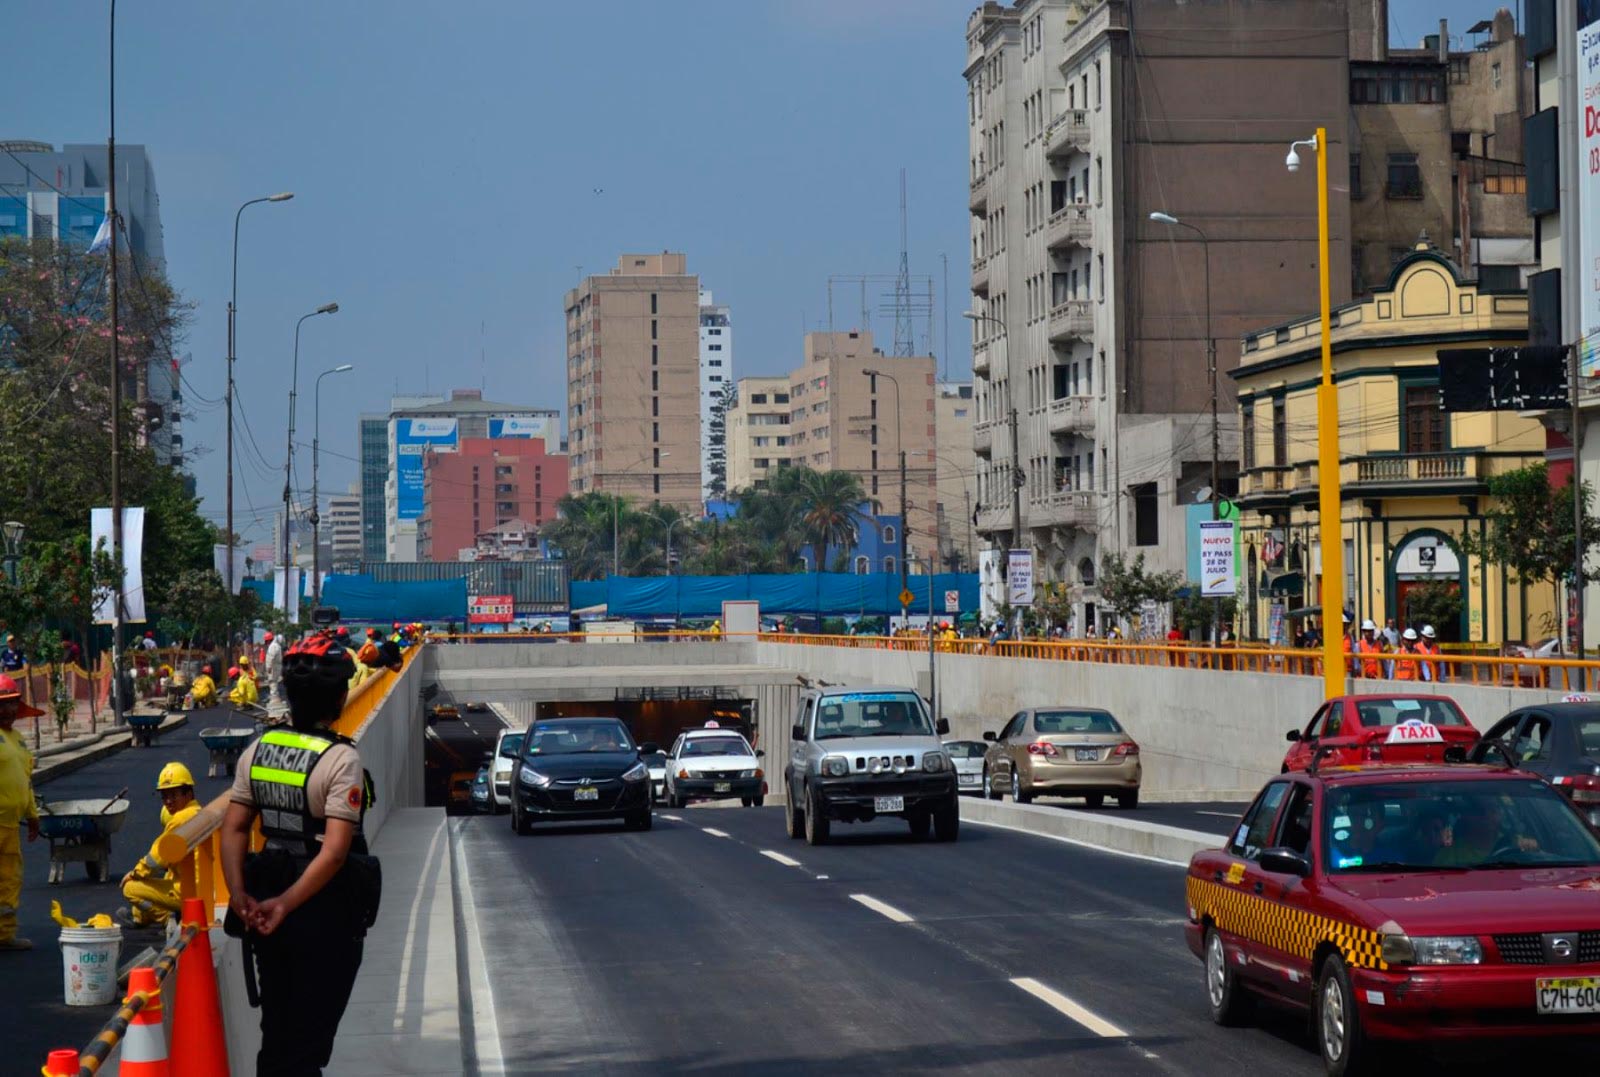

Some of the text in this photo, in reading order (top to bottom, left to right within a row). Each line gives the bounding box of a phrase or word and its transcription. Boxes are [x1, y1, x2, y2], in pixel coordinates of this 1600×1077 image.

[1397, 726, 1435, 739] TAXI
[254, 743, 311, 773] POLICIA
[79, 952, 108, 964] ideal
